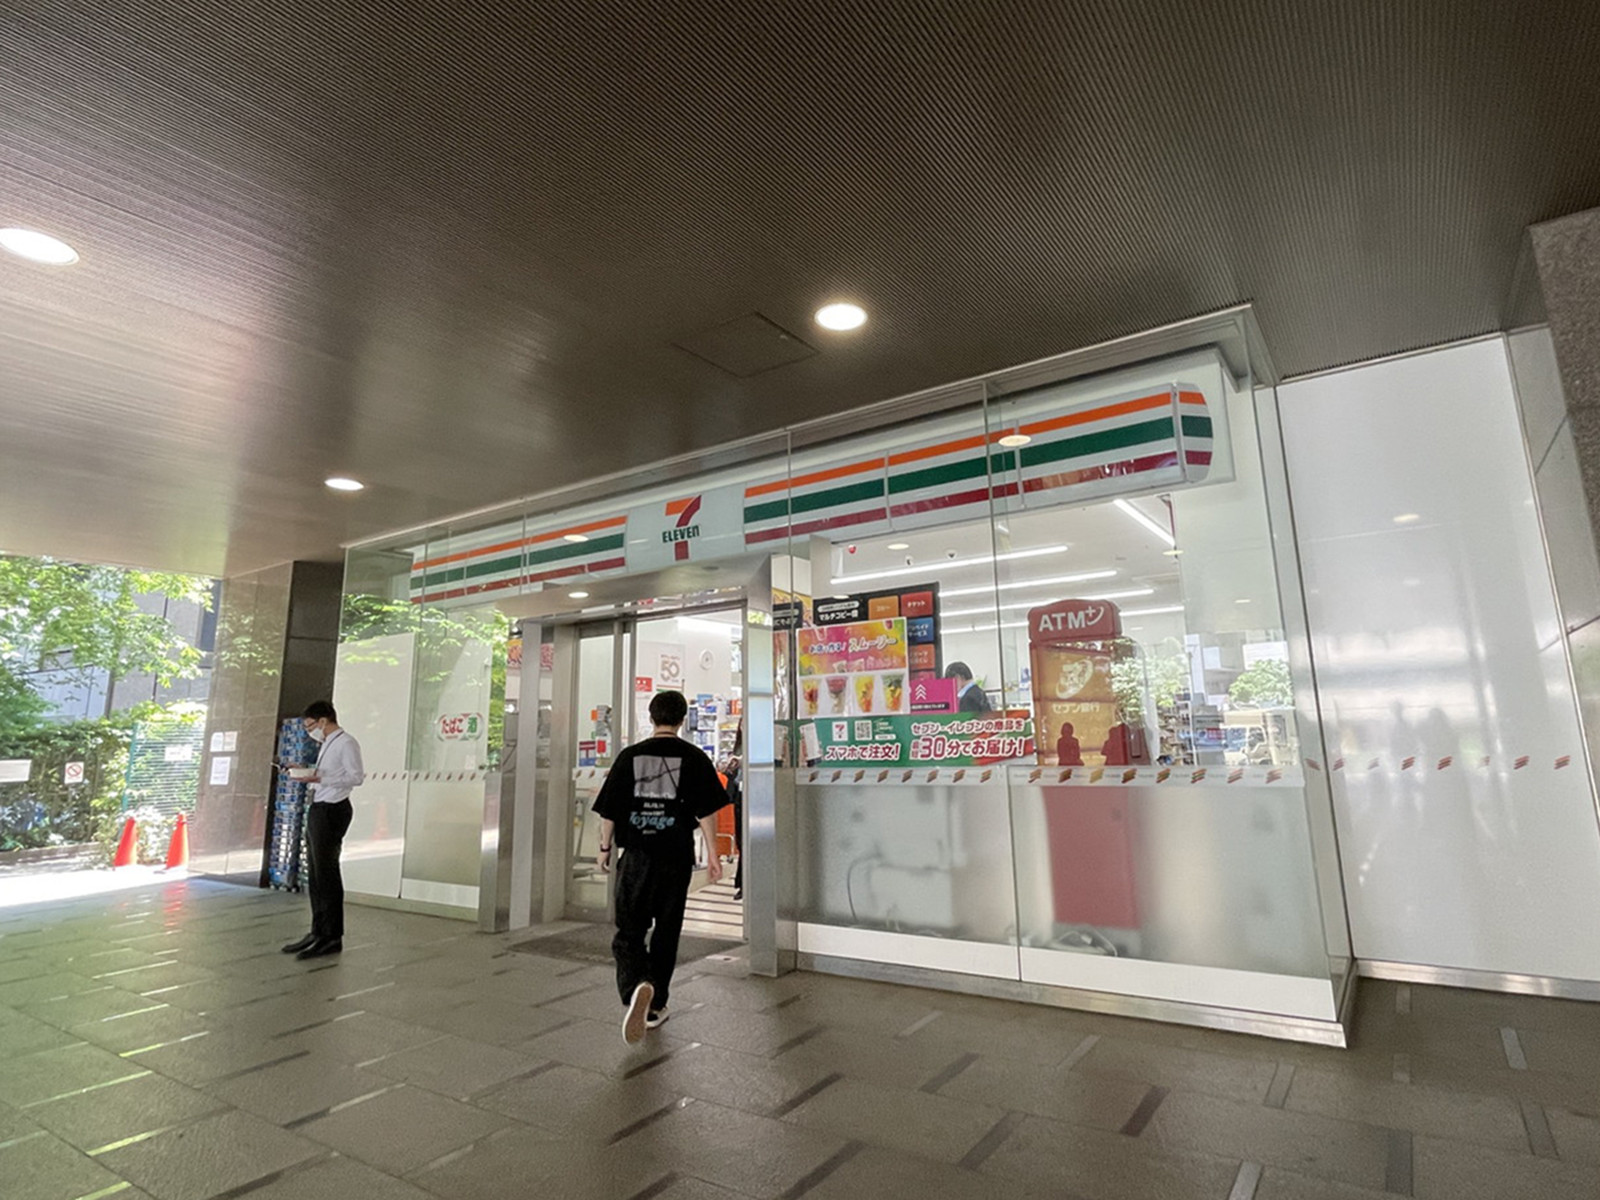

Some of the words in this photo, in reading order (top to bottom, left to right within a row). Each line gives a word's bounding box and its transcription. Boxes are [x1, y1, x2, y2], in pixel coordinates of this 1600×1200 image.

[825, 743, 900, 760] スマホで注文!
